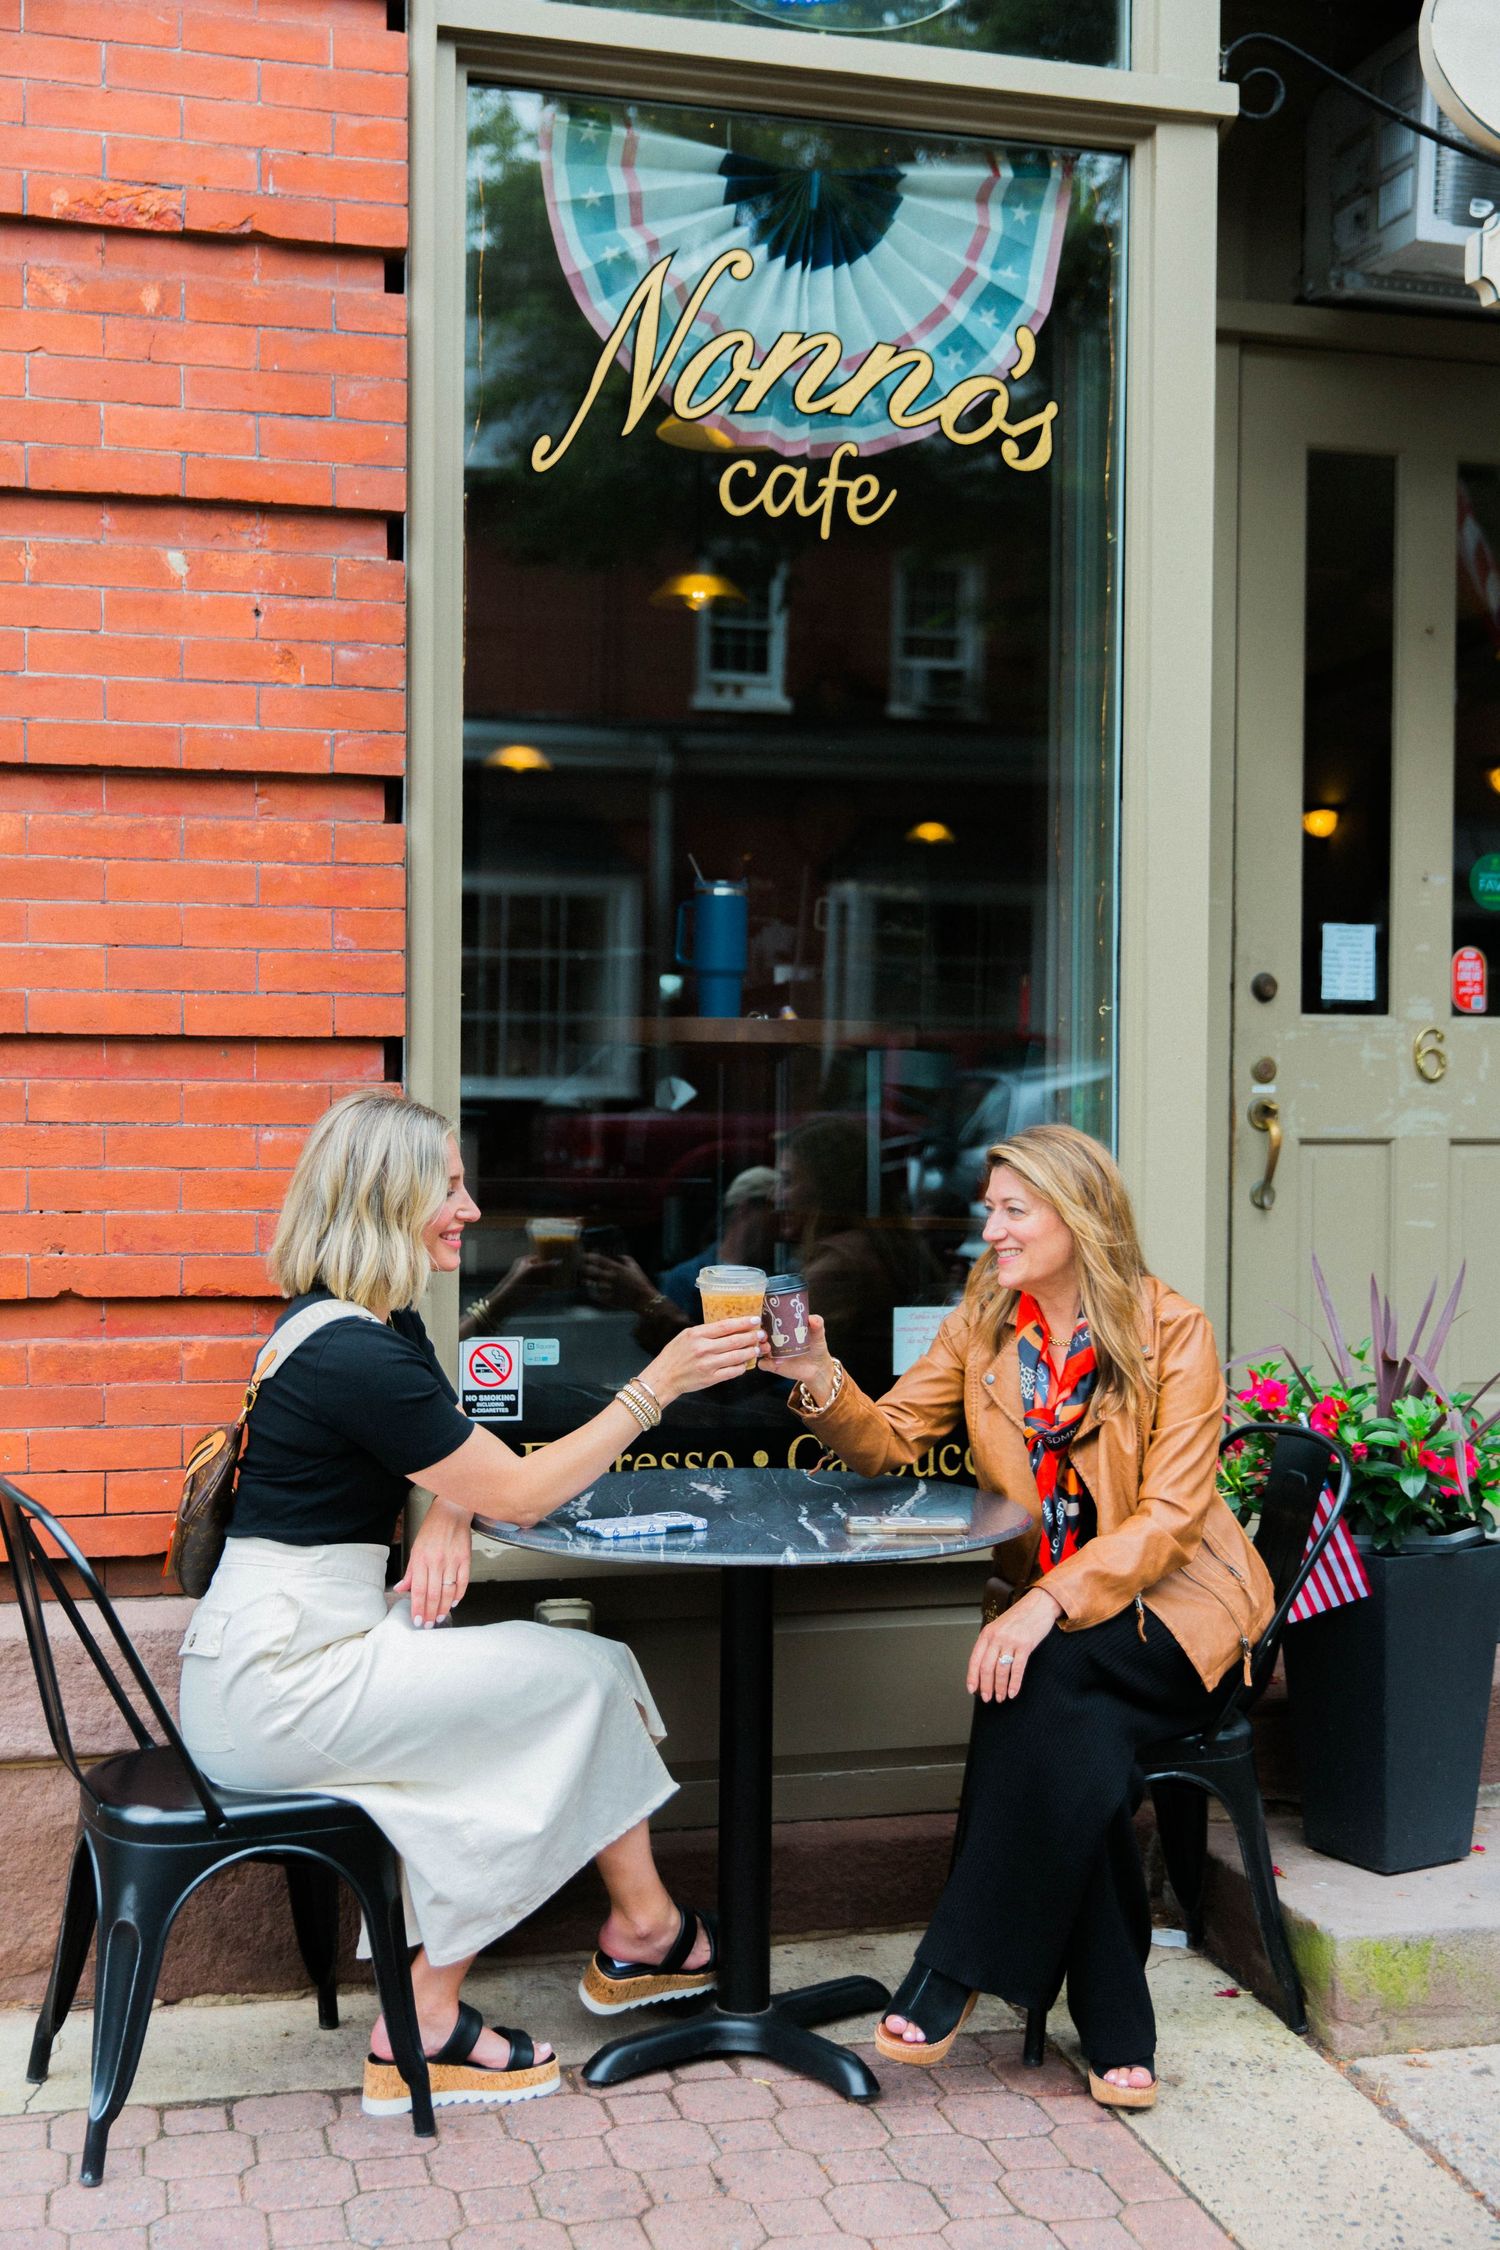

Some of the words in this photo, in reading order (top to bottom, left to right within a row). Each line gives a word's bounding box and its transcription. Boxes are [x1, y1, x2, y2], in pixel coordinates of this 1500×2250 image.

[531, 248, 1059, 473] Nonno's
[718, 442, 897, 540] cafe
[1413, 1026, 1446, 1084] 6
[465, 1394, 478, 1402] NO
[478, 1394, 516, 1402] SMOKING
